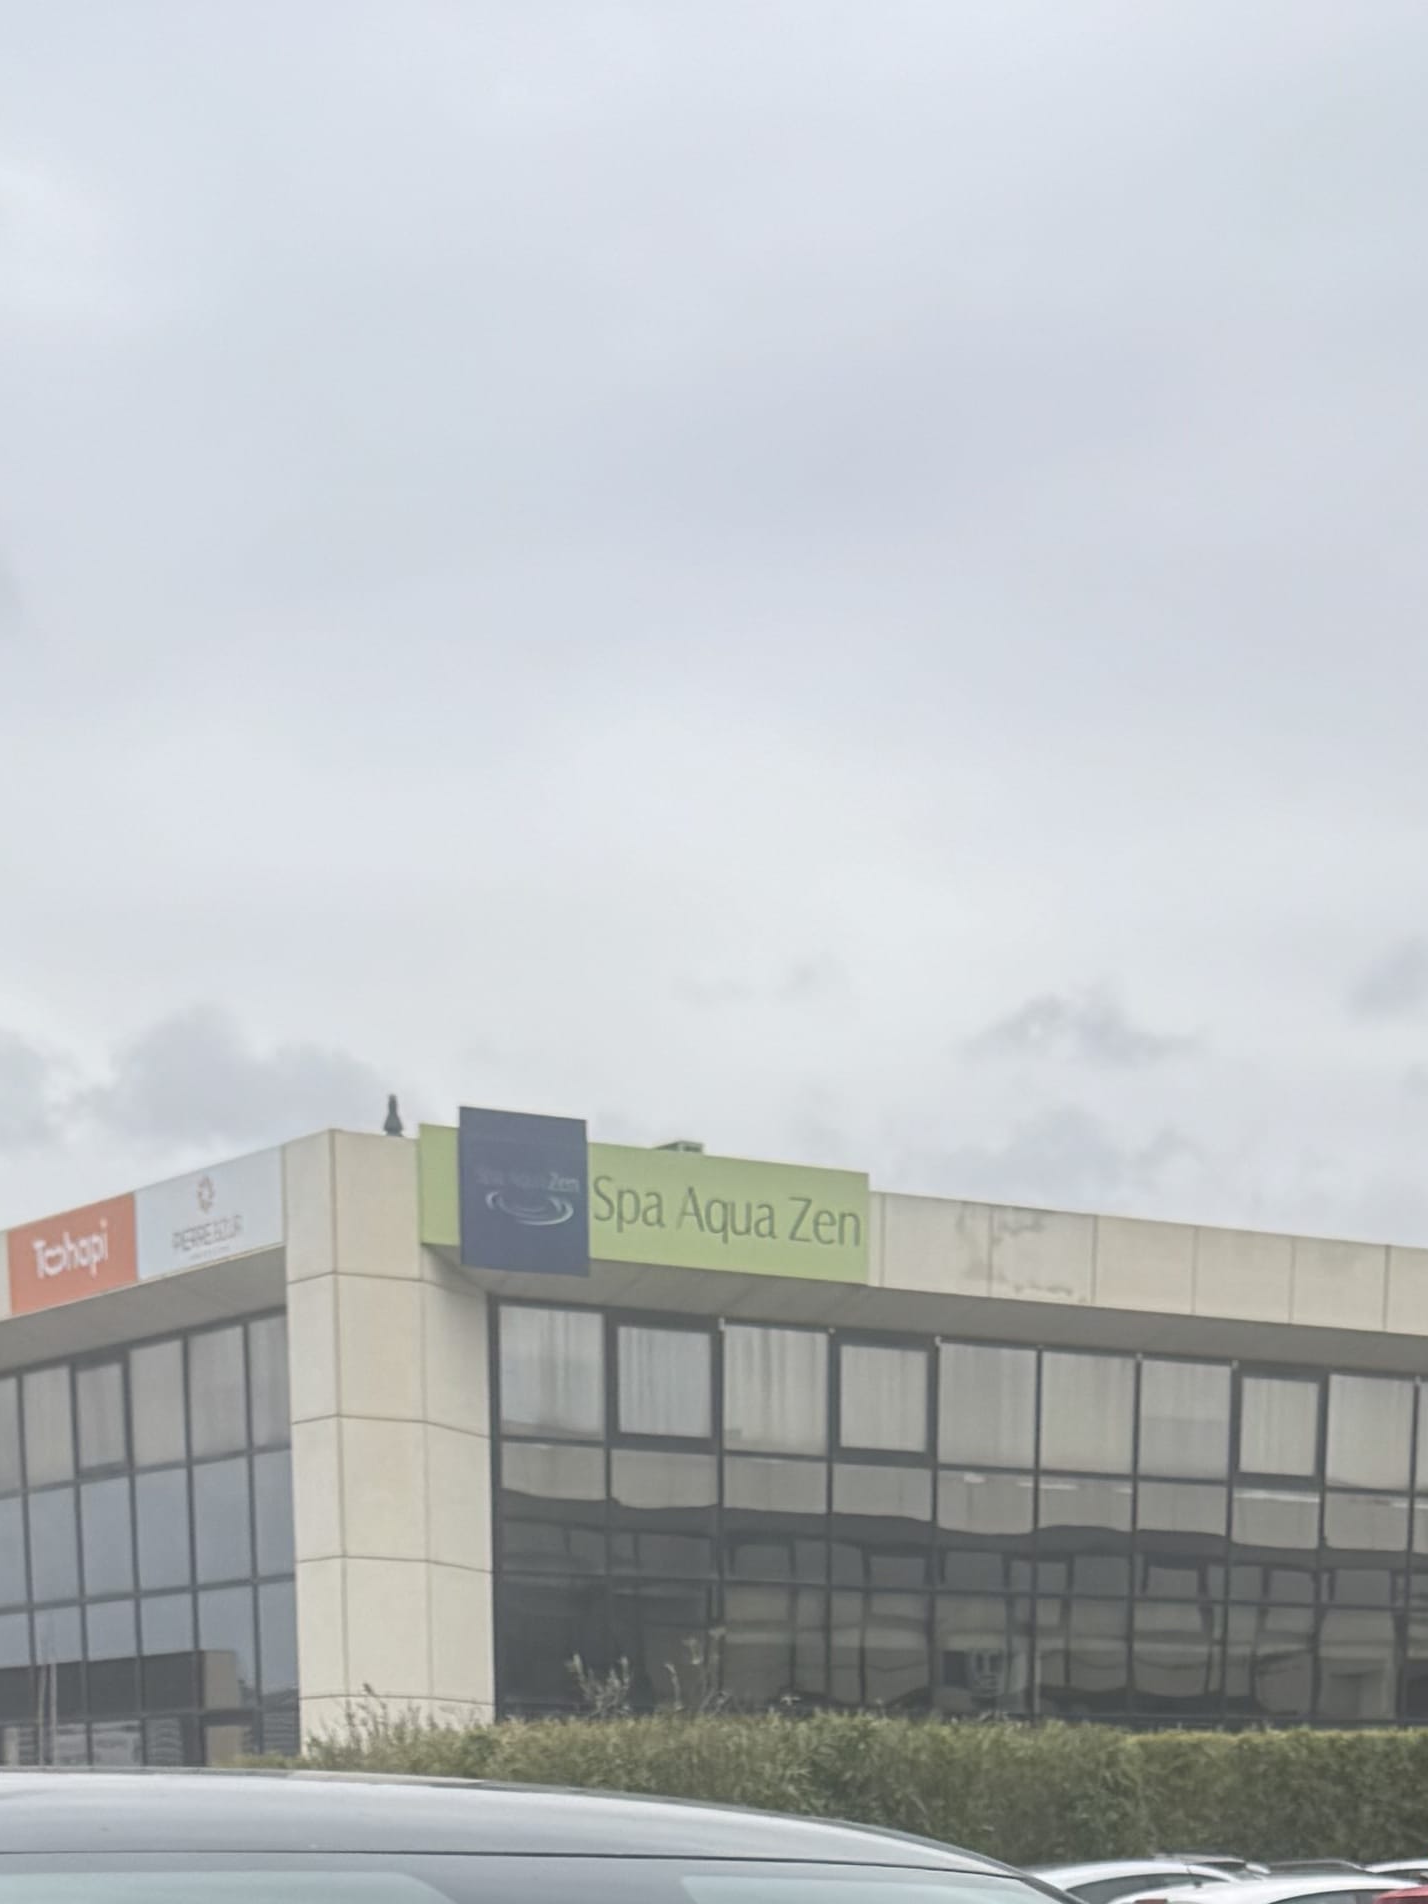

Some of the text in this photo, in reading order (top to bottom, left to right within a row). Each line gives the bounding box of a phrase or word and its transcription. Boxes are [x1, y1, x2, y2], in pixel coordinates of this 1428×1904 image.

[592, 1174, 861, 1246] Spa Aqua Zen
